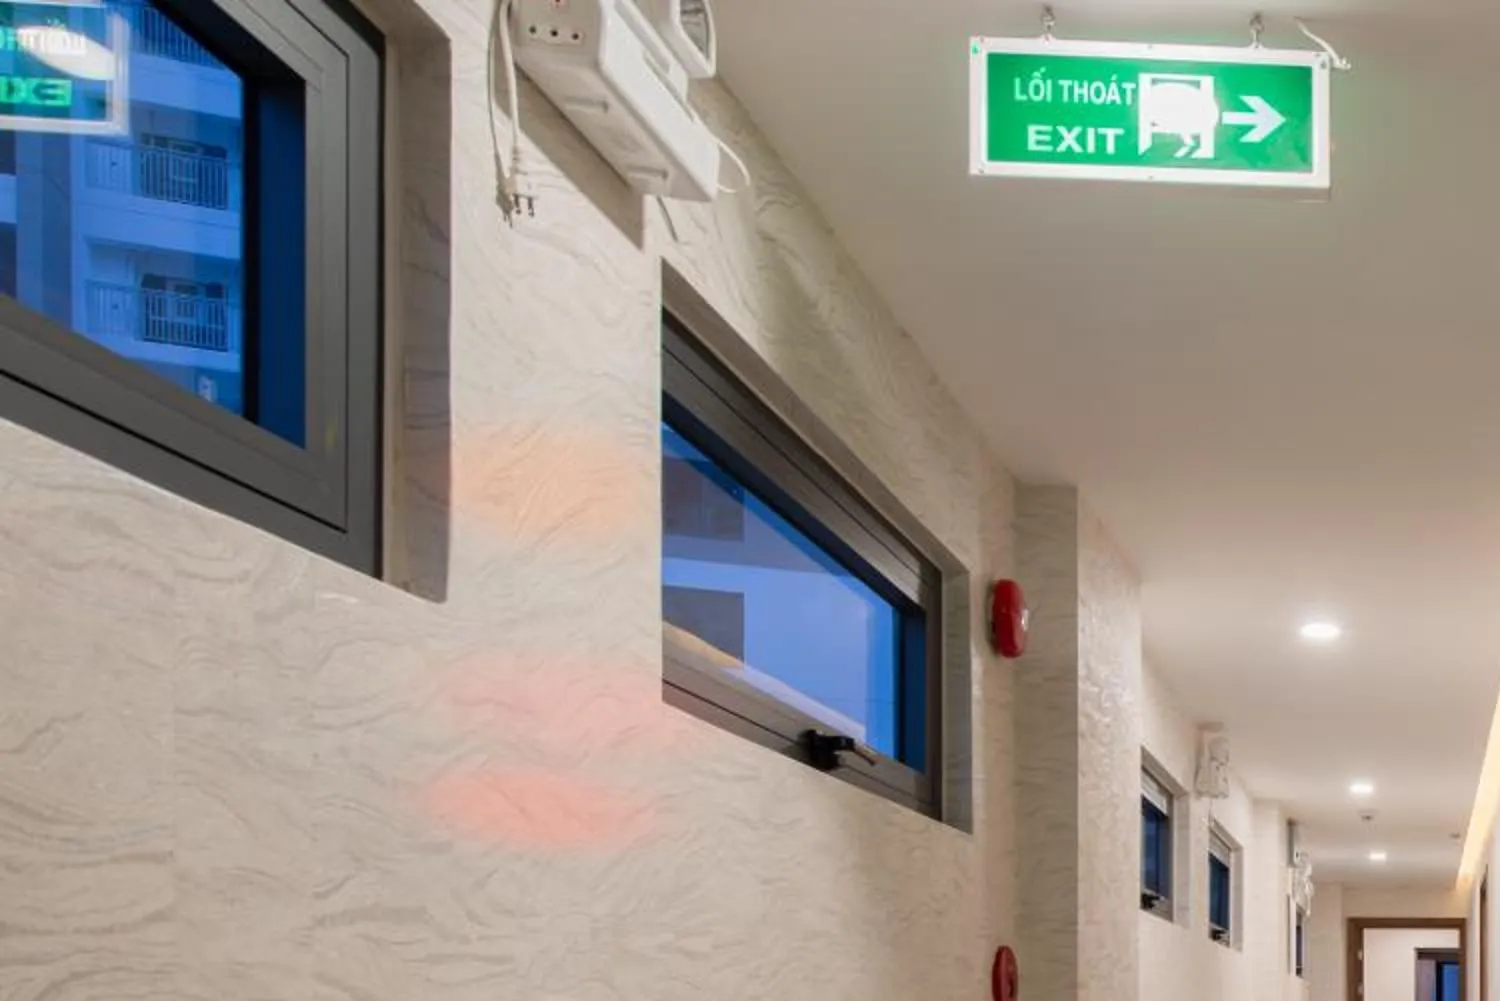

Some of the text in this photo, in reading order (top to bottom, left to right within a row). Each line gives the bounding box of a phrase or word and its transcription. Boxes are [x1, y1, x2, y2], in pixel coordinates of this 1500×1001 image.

[1014, 66, 1136, 106] LỐI THOÁT
[1027, 125, 1125, 154] EXIT
